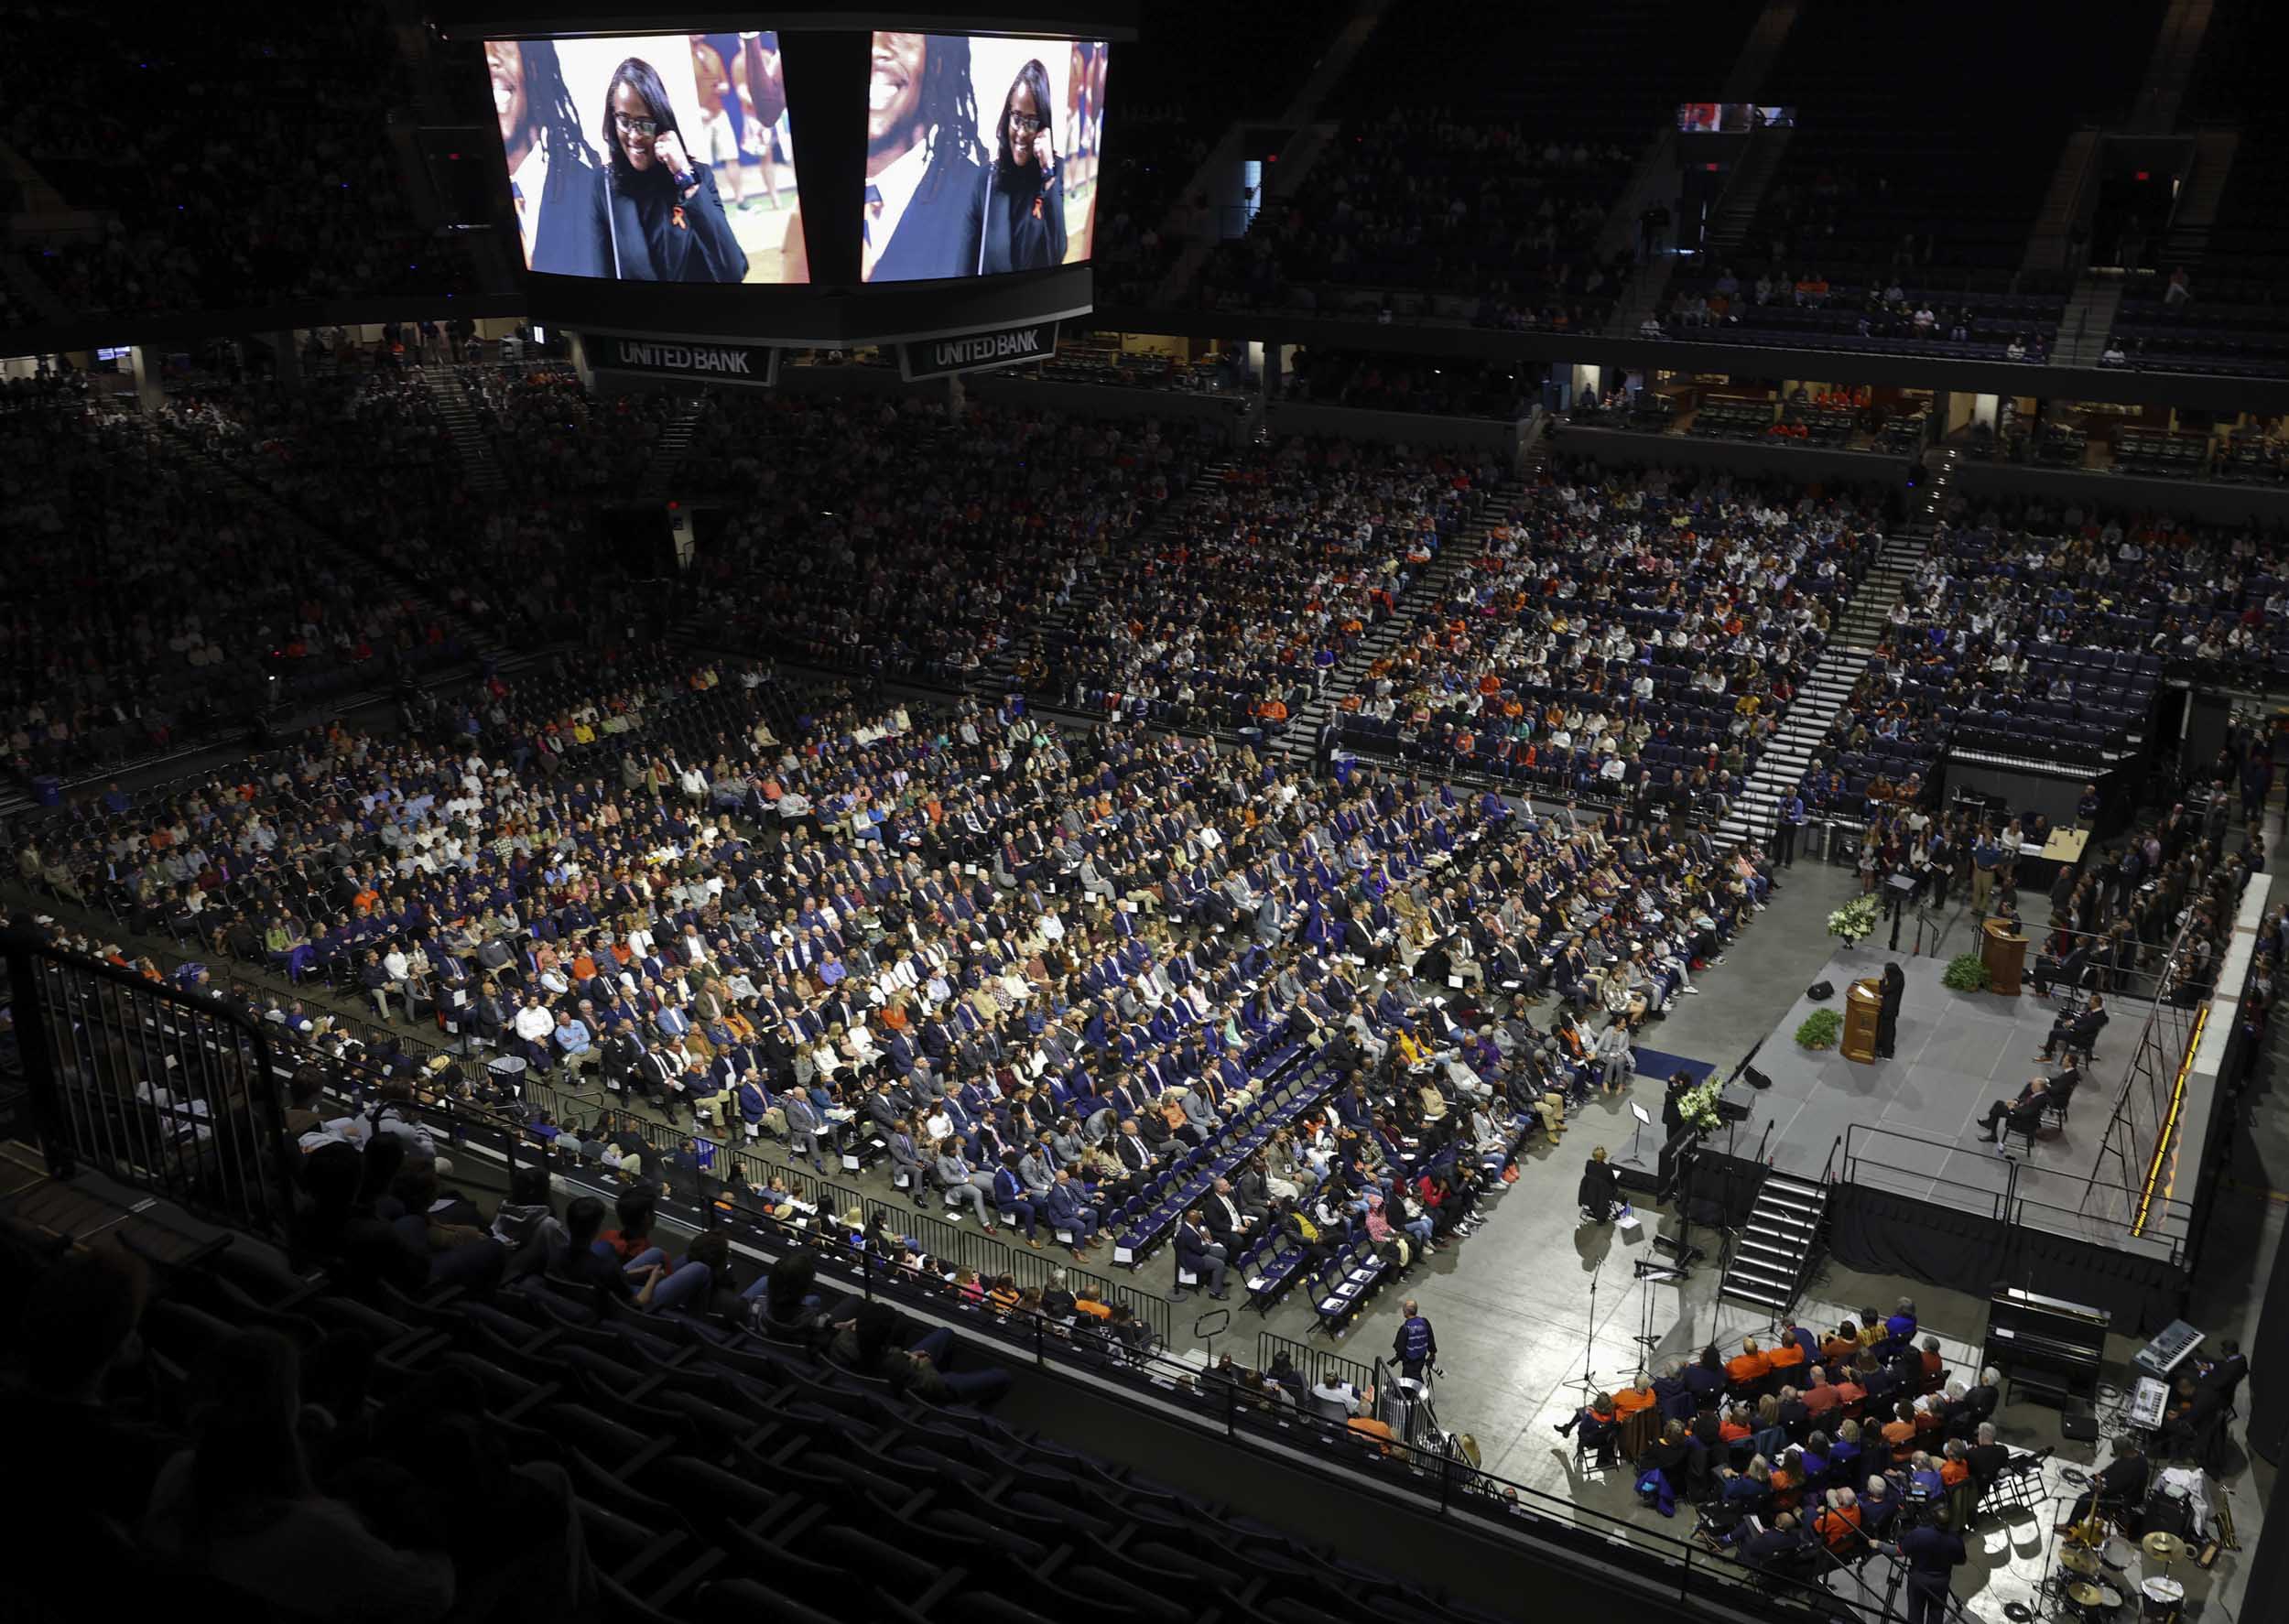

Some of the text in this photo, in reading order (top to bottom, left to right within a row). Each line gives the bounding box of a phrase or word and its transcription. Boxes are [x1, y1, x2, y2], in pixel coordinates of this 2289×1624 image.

[619, 341, 751, 374] UNITED BANK
[936, 330, 1039, 366] UNITED BANK
